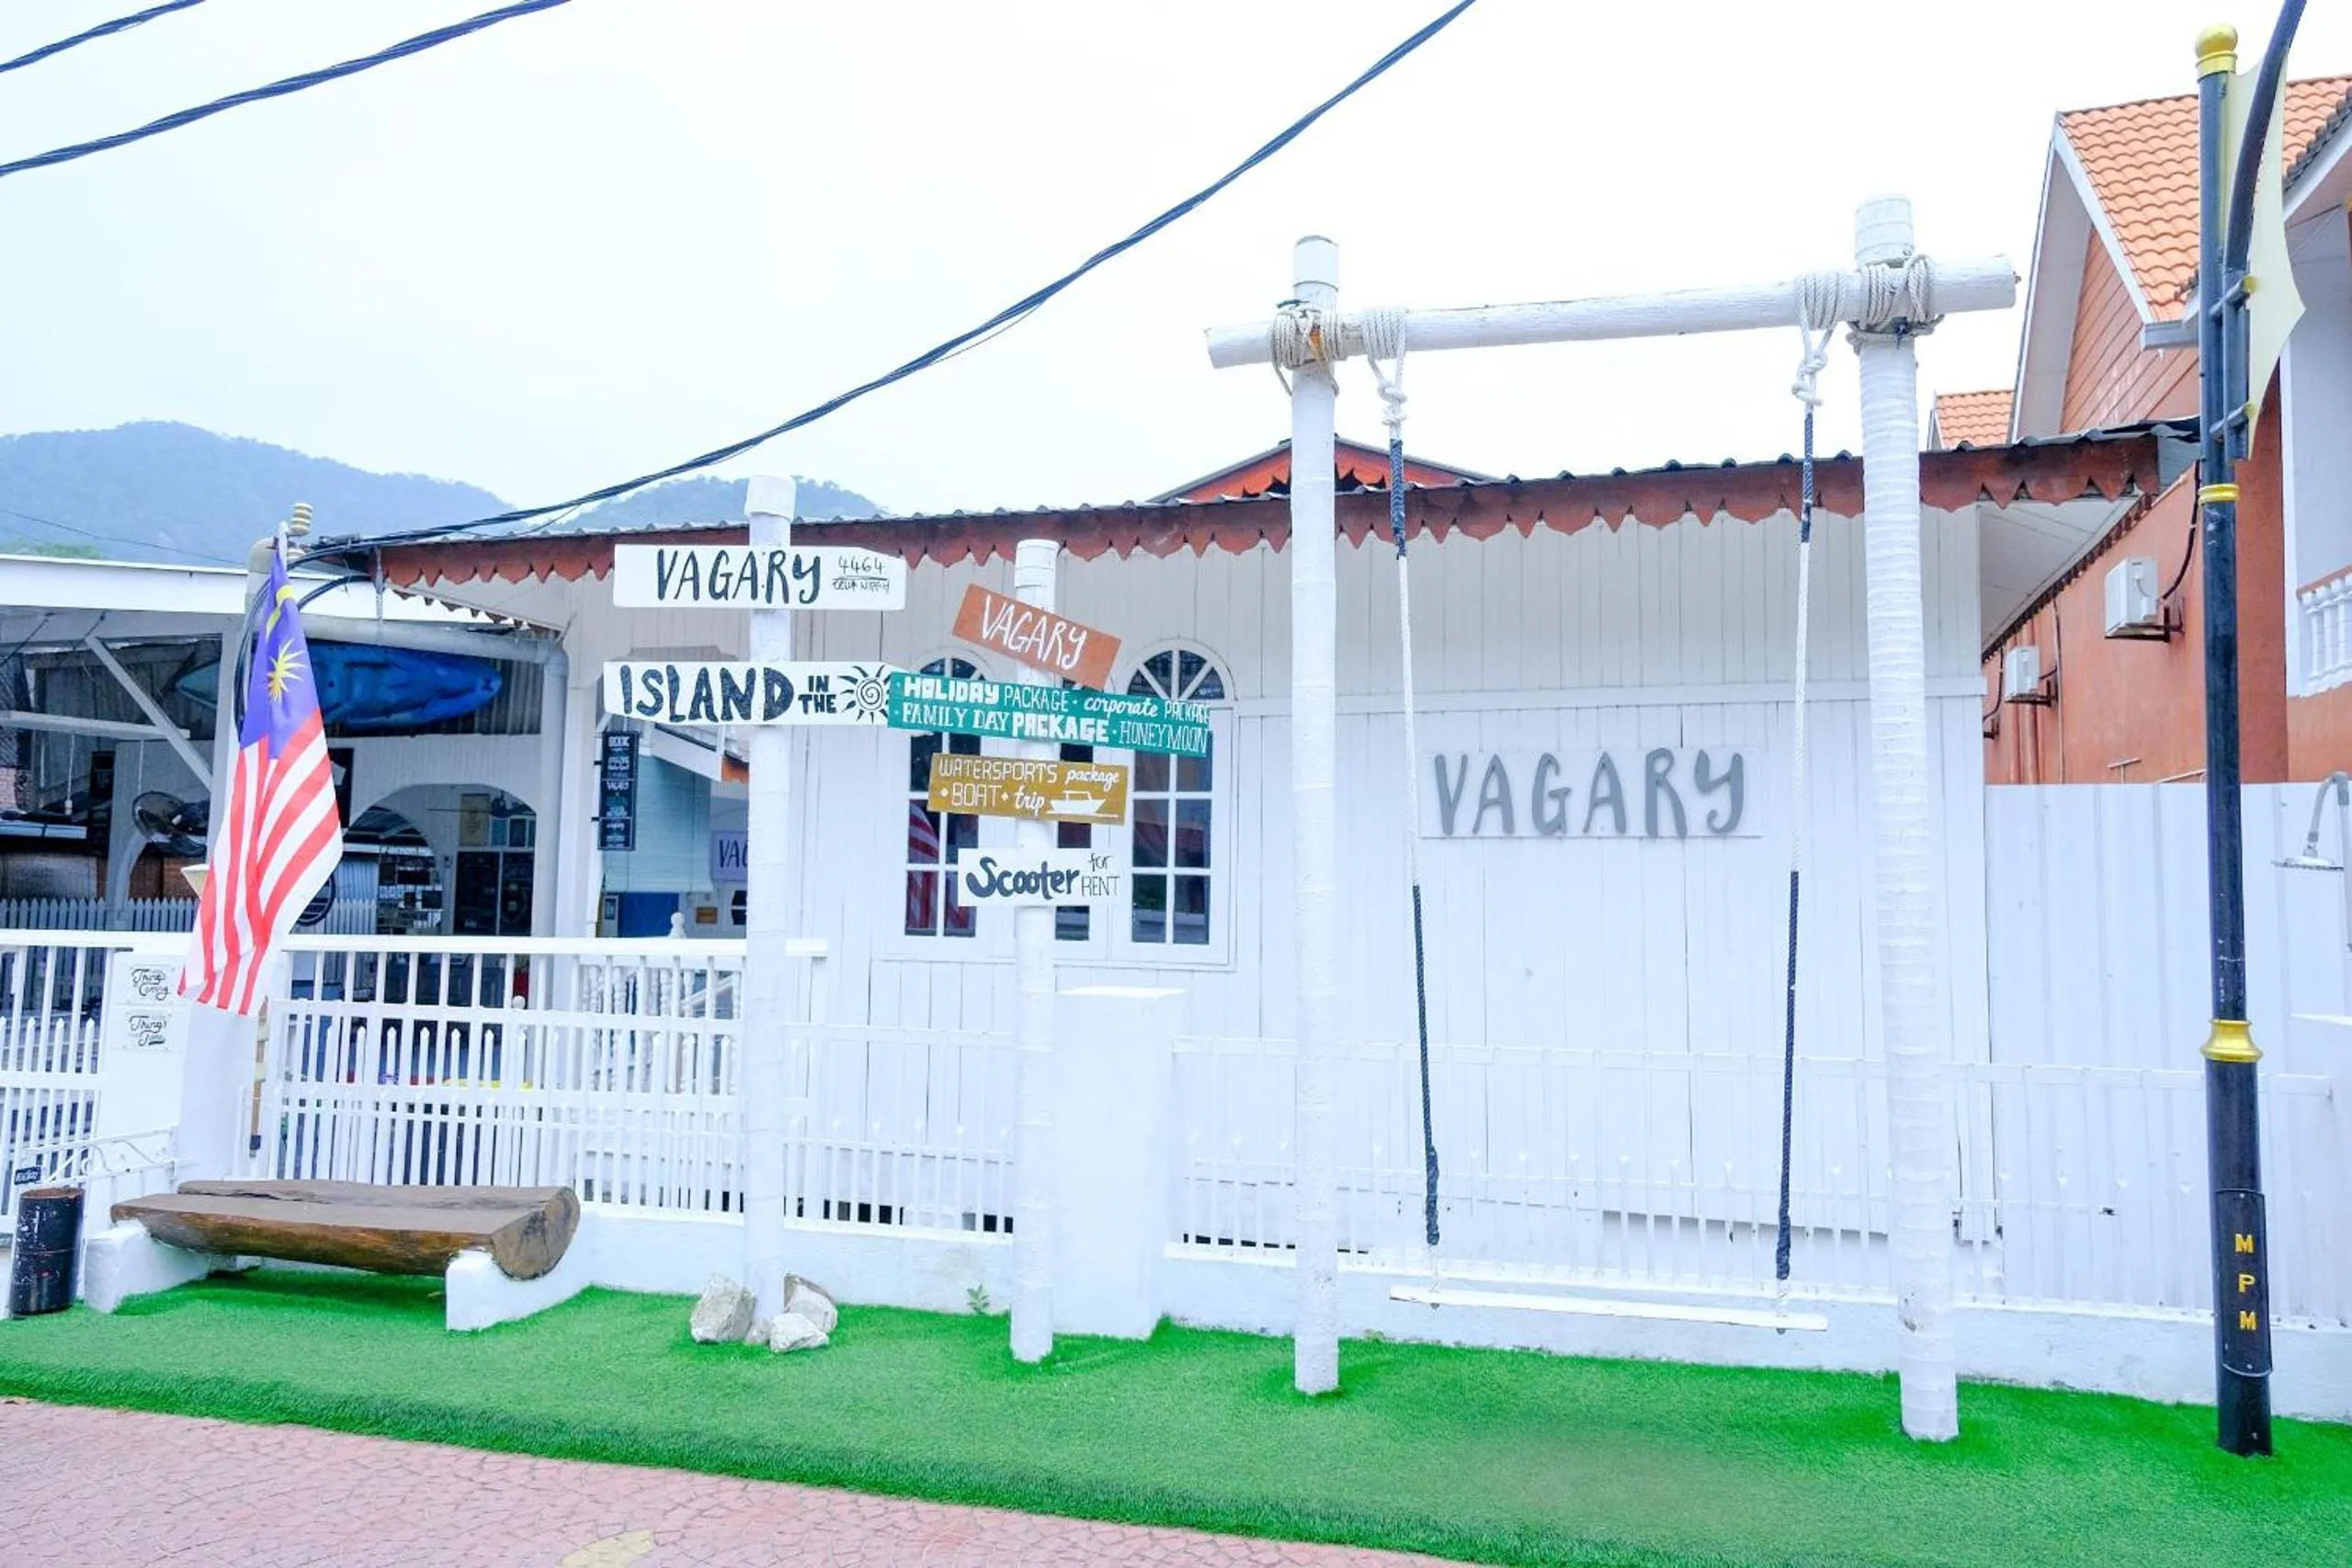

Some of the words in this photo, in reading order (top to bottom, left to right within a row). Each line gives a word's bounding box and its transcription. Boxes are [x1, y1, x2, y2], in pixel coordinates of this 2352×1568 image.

[656, 549, 821, 604] VAGARY
[838, 555, 886, 574] 4464
[980, 595, 1088, 670] VAGARY
[620, 665, 794, 722] ISLAND
[798, 695, 836, 714] THE
[807, 676, 830, 692] IN
[904, 676, 1000, 705] HOLIDAY
[1004, 686, 1069, 712] PACKAGE
[1084, 697, 1158, 719] corporate
[903, 702, 968, 728] FAMILY
[972, 710, 1010, 731] DAY
[1012, 712, 1109, 743] PACKAGE
[1119, 721, 1209, 753] HONEYMOON
[938, 757, 1058, 783] WATERSPORTS
[1064, 766, 1119, 791] package
[1434, 747, 1744, 839] VAGARY
[952, 783, 1002, 808] BOAT
[1014, 786, 1045, 815] trip
[965, 857, 1080, 900] Scooter
[1082, 876, 1119, 896] RENT
[1088, 852, 1113, 871] for
